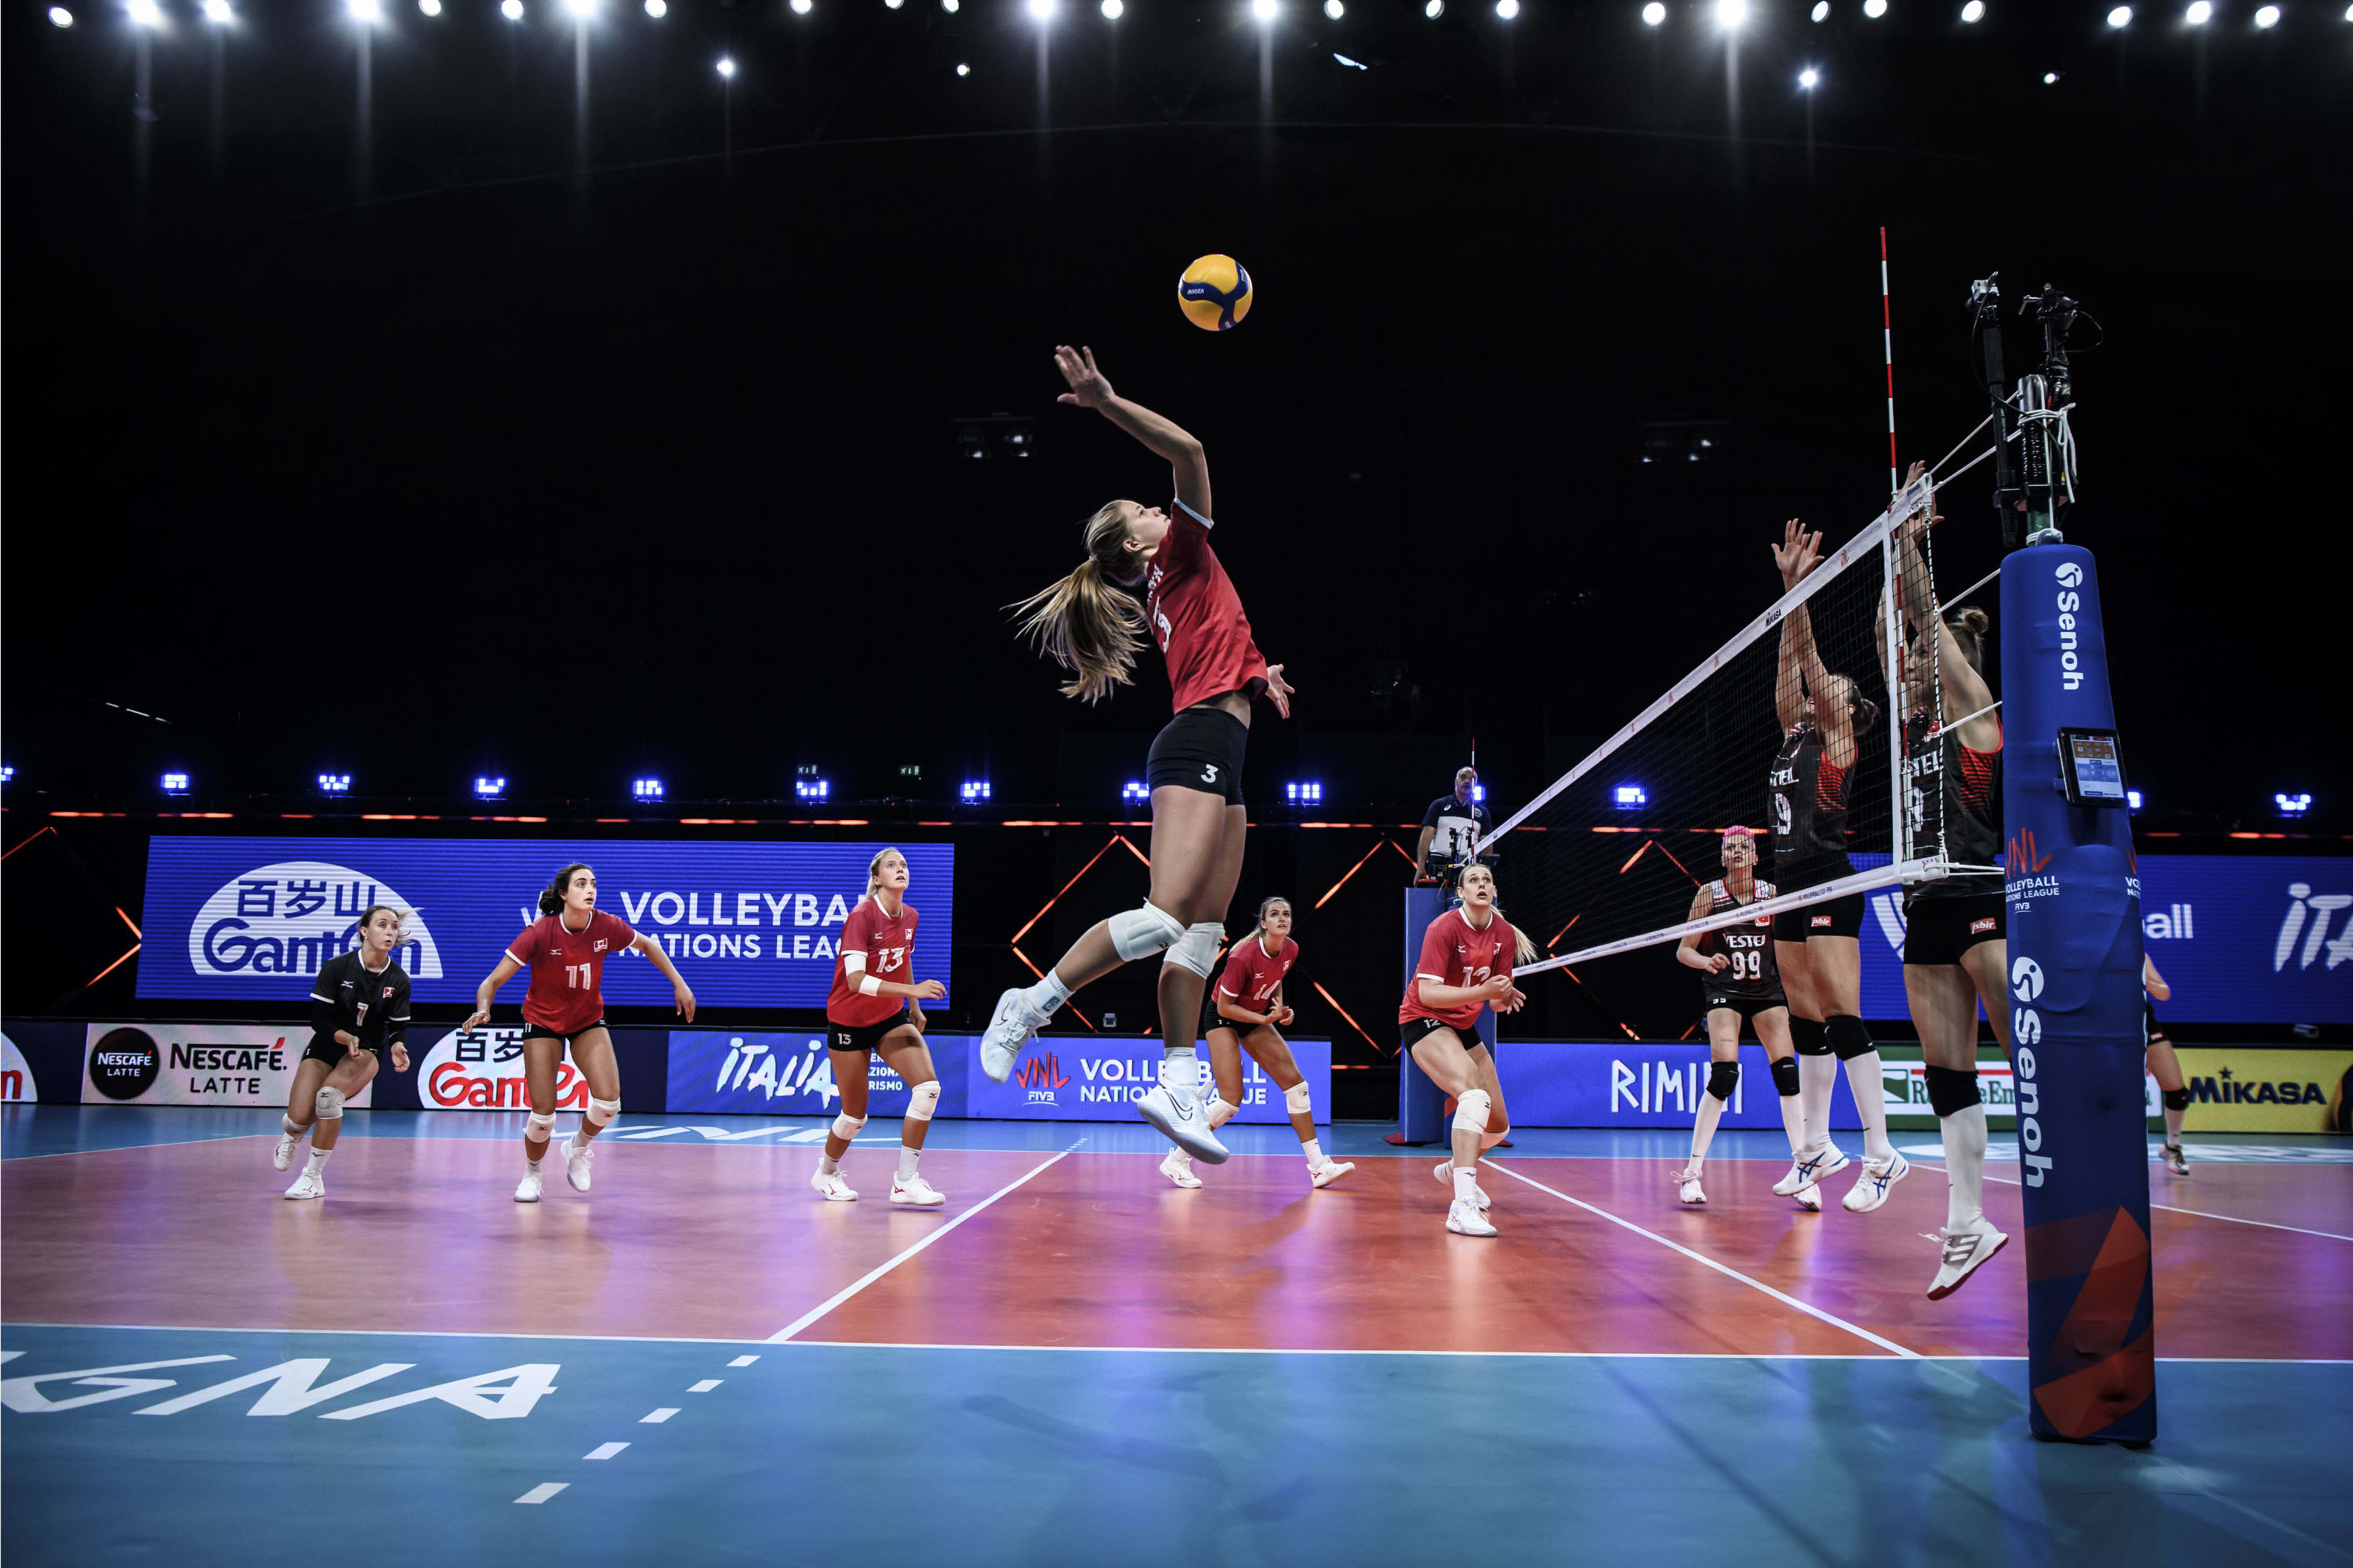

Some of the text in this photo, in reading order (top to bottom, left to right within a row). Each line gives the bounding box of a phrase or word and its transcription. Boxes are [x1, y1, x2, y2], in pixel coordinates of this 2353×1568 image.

[2058, 591, 2083, 690] Senoh
[1201, 764, 1218, 783] 3
[2006, 876, 2059, 894] VOLLEYBALL
[2024, 888, 2059, 898] LEAGUE
[237, 879, 377, 918] 百岁山
[620, 892, 866, 926] VOLLEYBA
[776, 935, 842, 959] LEA
[876, 947, 906, 973] 13
[1732, 951, 1760, 980] 99
[566, 963, 591, 990] 11
[357, 1002, 369, 1026] 7
[456, 1028, 566, 1063] 百岁
[838, 1033, 852, 1045] 13
[107, 1068, 141, 1077] LATTE
[190, 1077, 261, 1094] LATTE
[868, 1081, 903, 1091] RISMO
[1081, 1085, 1155, 1102] NATIO
[2015, 1007, 2053, 1188] Senoh
